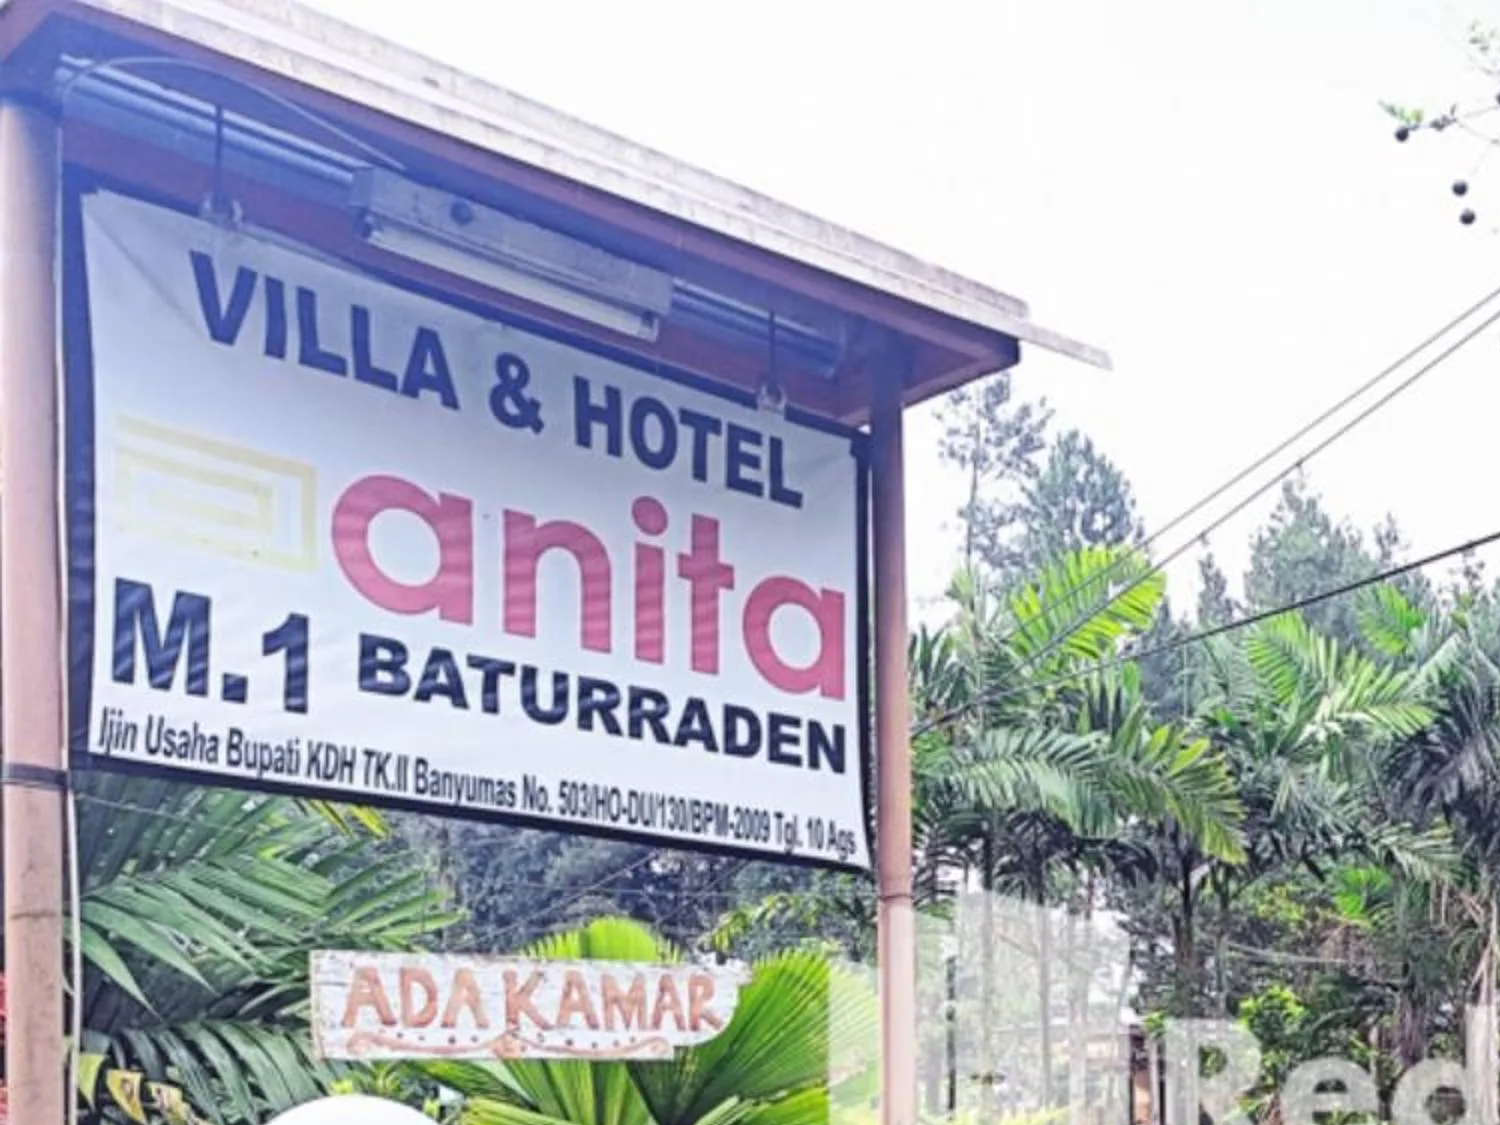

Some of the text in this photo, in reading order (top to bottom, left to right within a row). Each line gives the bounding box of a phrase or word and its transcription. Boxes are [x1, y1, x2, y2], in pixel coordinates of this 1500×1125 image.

[190, 249, 804, 510] VILLA & HOTEL
[111, 577, 846, 774] M.1 BATURRADEN
[331, 473, 846, 702] anita
[99, 707, 138, 756] Ijin
[145, 714, 219, 762] Usaha
[226, 728, 300, 779] Bupati
[306, 740, 355, 782] KDH
[363, 749, 408, 791] TK.II
[415, 758, 517, 807] Banyumas
[522, 774, 553, 812] No.
[773, 812, 802, 854] Tgl.
[806, 816, 825, 850] 10
[827, 820, 857, 861] Ags
[341, 966, 723, 1031] ADA KAMAR
